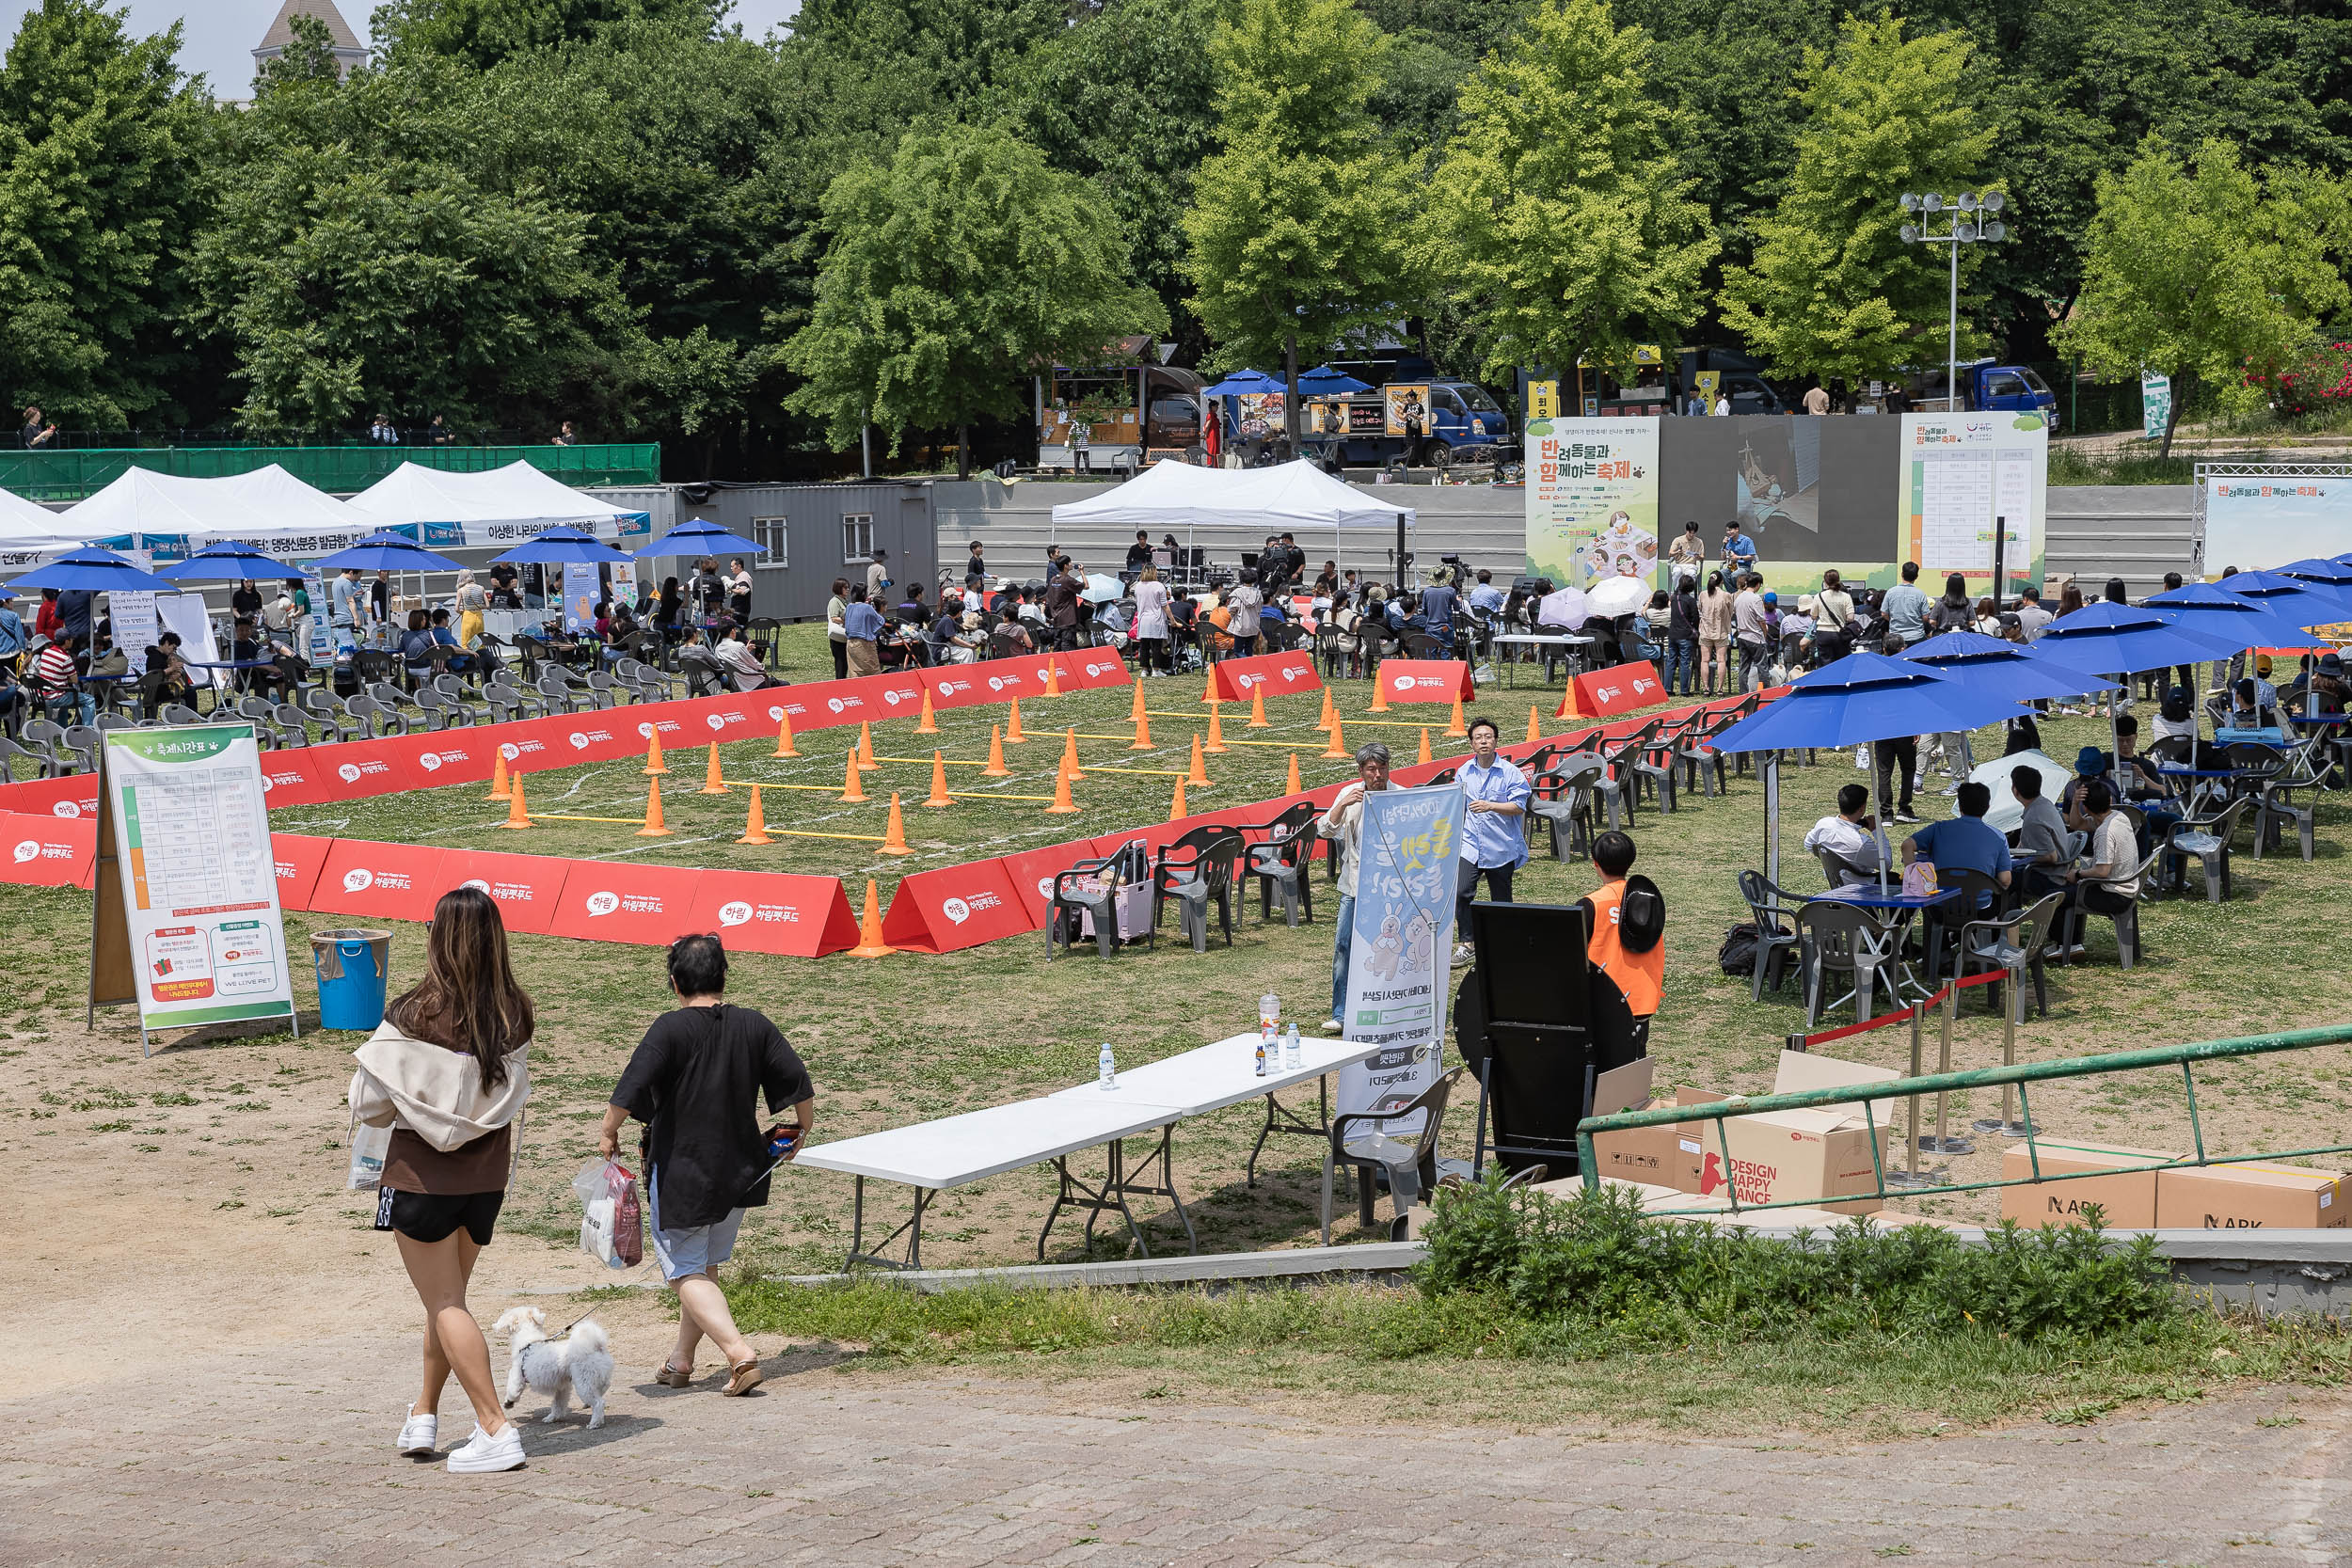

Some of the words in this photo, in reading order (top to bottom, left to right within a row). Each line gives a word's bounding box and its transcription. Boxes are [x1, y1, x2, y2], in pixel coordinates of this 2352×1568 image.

[1541, 439, 1610, 461] 반려동물과
[2218, 485, 2260, 498] 반려동물과
[488, 525, 516, 540] 이상한
[271, 536, 318, 553] 댕댕신분증
[156, 741, 207, 756] 축제시간표
[519, 743, 546, 753] 하림펫푸드
[422, 756, 438, 766] 하림
[442, 752, 469, 763] 하림펫푸드
[342, 768, 358, 777] 하림
[361, 764, 389, 775] 하림펫푸드
[274, 775, 305, 784] 하림펫푸드
[19, 846, 35, 856] 하림
[40, 847, 73, 859] 하림펫푸드
[275, 867, 296, 879] 펫푸드
[350, 874, 367, 885] 하림
[374, 877, 412, 890] 하림펫푸드
[492, 888, 533, 900] 하림펫푸드
[593, 895, 612, 909] 하림
[622, 899, 663, 913] 하림펫푸드
[969, 896, 1002, 911] 하림펫푸드
[724, 907, 746, 919] 하림
[946, 903, 963, 914] 하림
[755, 910, 800, 923] 하림펫푸드
[1729, 1159, 1777, 1180] DESIGN
